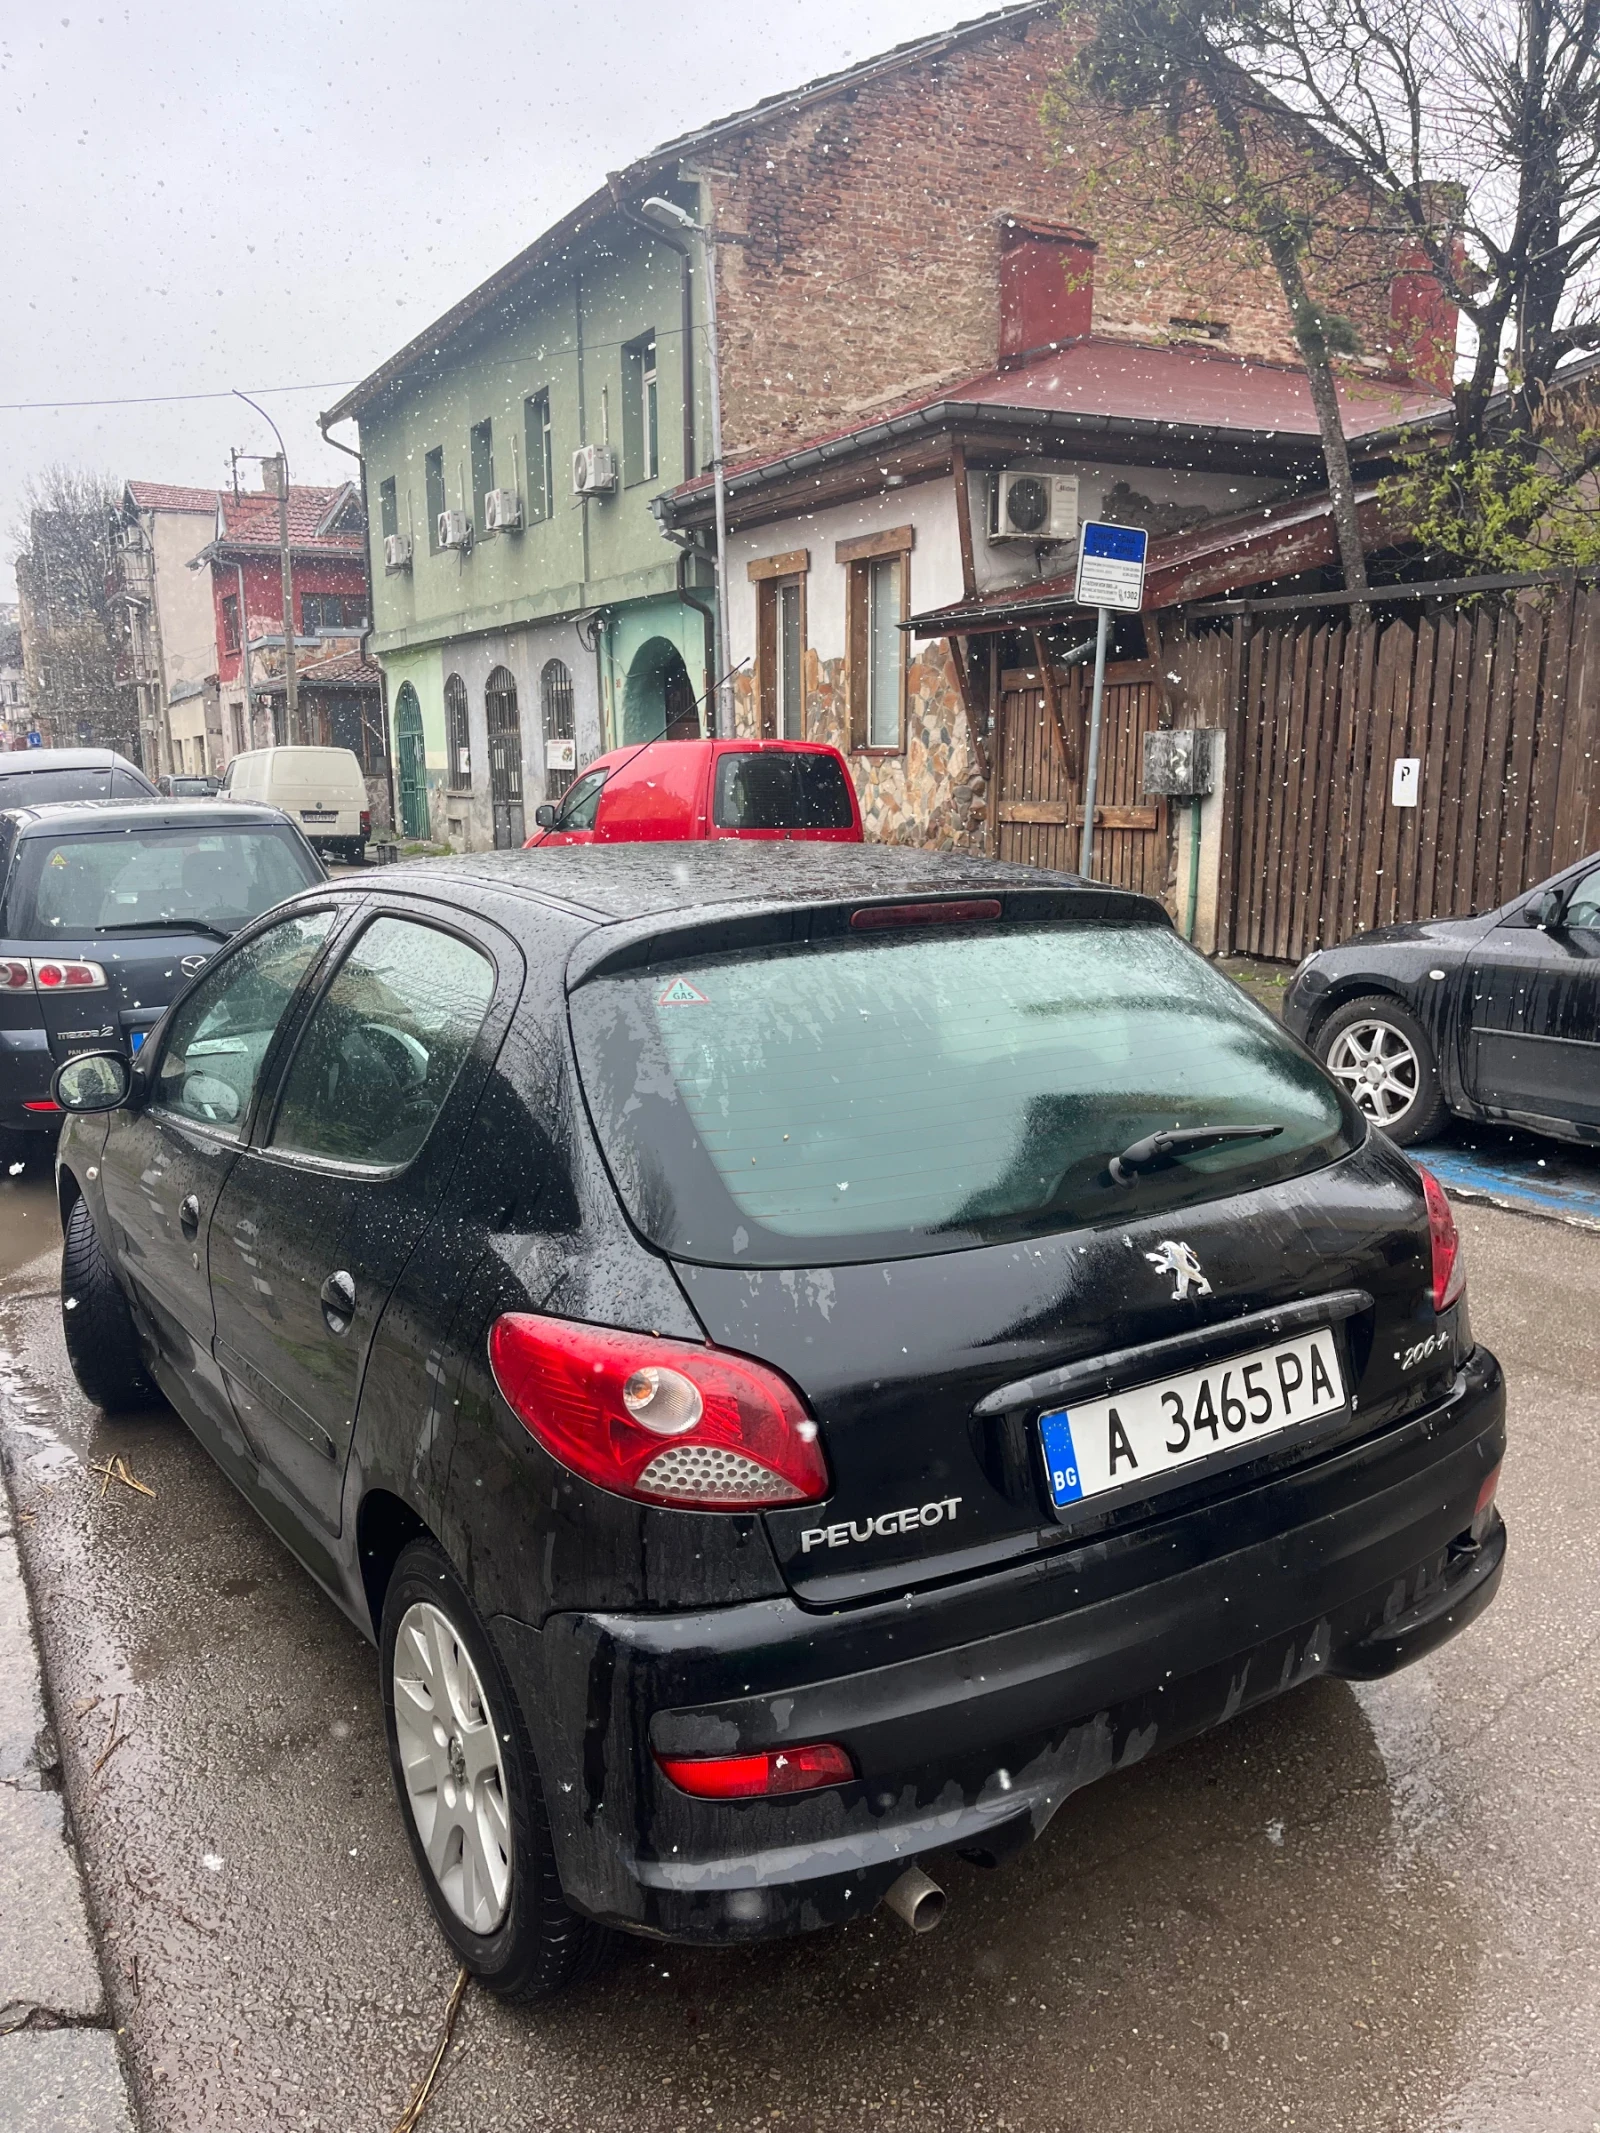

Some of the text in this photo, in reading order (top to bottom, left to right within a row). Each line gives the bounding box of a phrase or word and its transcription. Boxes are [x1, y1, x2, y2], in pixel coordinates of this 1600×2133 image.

[1123, 590, 1138, 600] 1302
[1401, 766, 1411, 782] P
[672, 992, 694, 1000] GAS
[1401, 1331, 1450, 1370] 206+
[1108, 1408, 1139, 1476] A
[1053, 1467, 1078, 1491] BG
[801, 1497, 963, 1553] PEUGEOT
